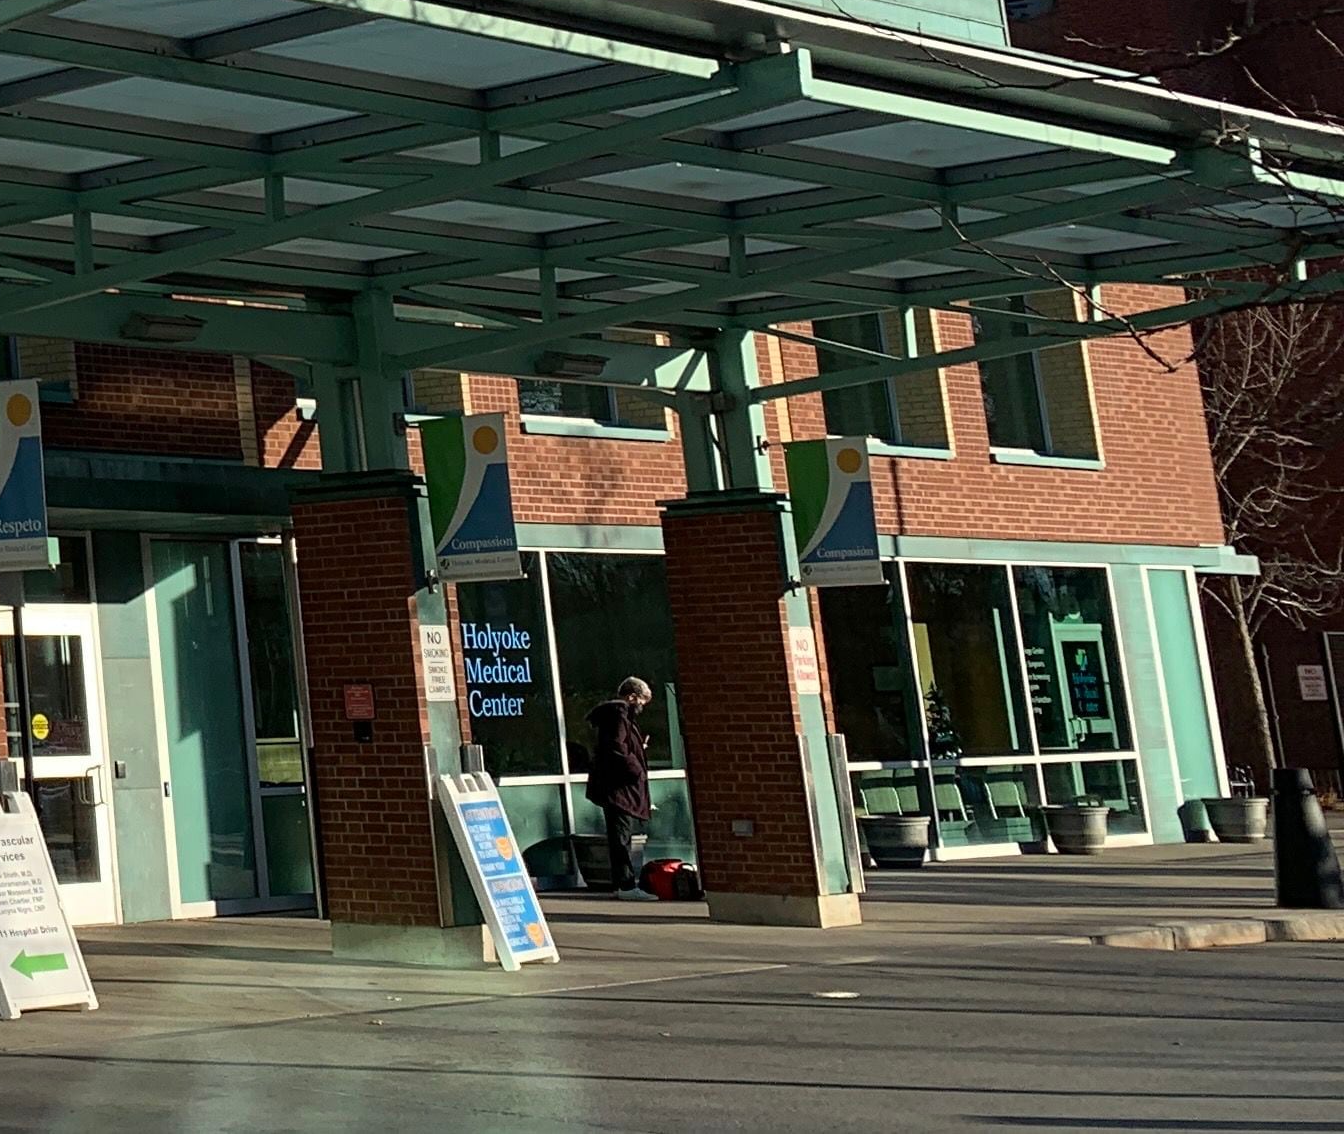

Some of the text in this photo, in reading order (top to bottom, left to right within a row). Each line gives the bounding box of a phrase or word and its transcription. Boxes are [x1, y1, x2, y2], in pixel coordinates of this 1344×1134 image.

[451, 535, 513, 551] Compassion
[426, 632, 441, 644] NO
[461, 623, 531, 657] Holyoke
[796, 639, 809, 651] NO
[424, 649, 449, 658] SMOKING
[465, 657, 532, 684] Medical
[428, 686, 451, 694] CAMPUS
[469, 690, 524, 717] Center
[0, 925, 58, 938] 11 Hospital Drive
